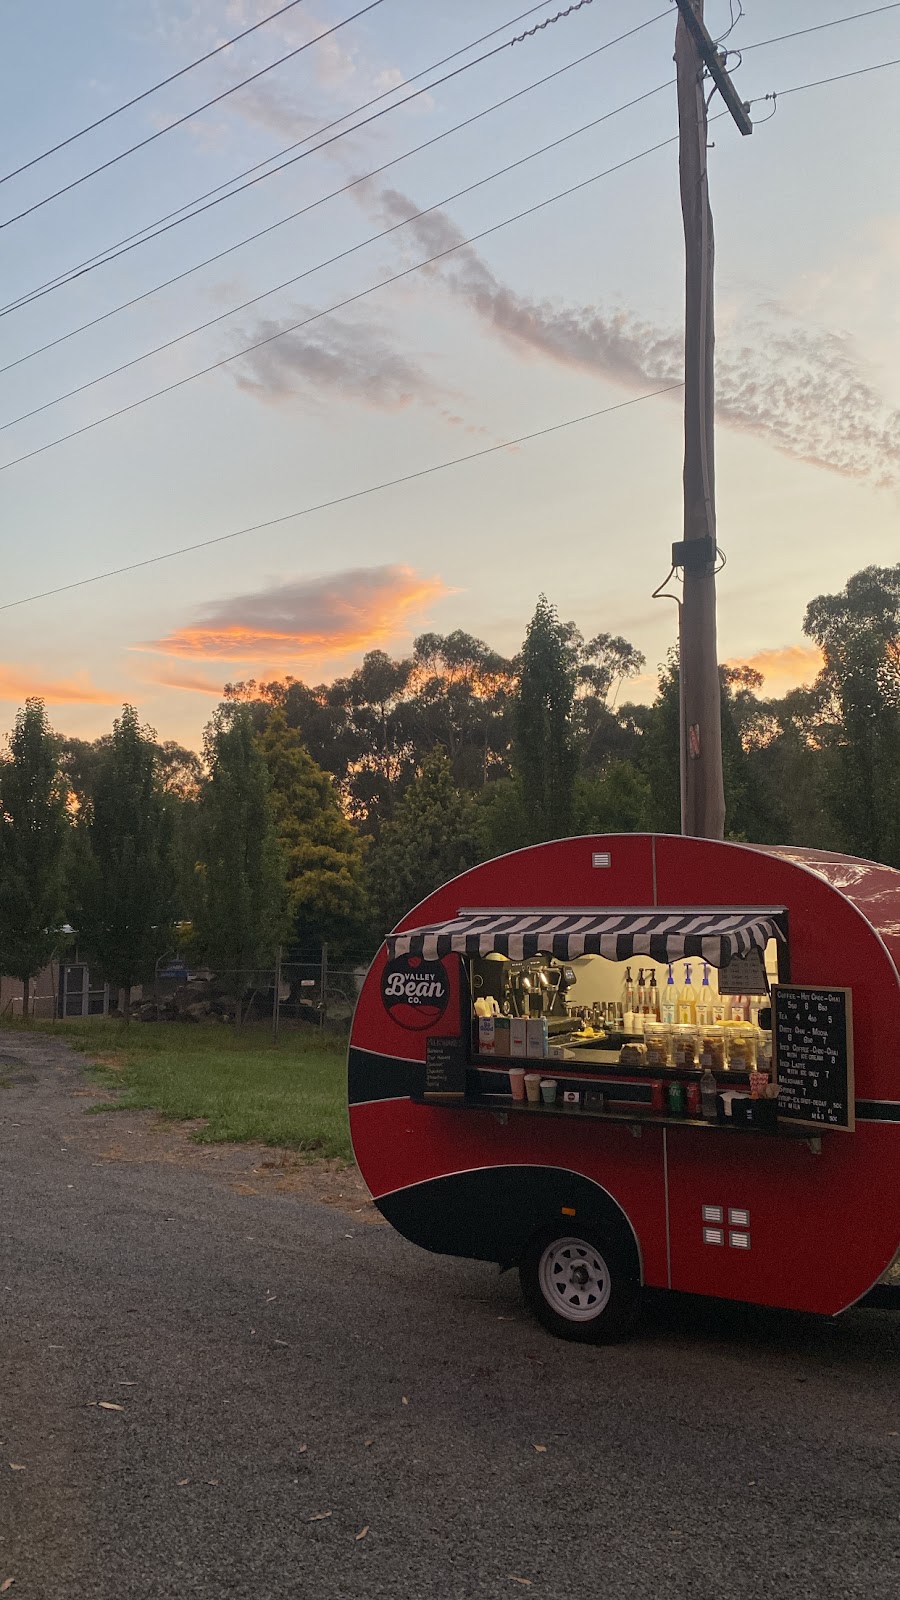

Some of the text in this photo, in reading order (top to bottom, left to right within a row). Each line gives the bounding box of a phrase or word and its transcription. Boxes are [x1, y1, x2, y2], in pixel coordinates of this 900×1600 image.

[405, 973, 435, 981] VALLEY
[384, 972, 445, 998] Bean
[777, 991, 796, 999] COFFEE
[407, 996, 422, 1004] CO.
[778, 1011, 788, 1020] TEA
[795, 1013, 800, 1021] 4
[827, 1015, 833, 1024] 5
[822, 1036, 827, 1045] 7
[791, 1060, 806, 1069] LATTE
[830, 1056, 836, 1064] 8
[825, 1070, 830, 1079] 7
[778, 1075, 818, 1087] MILKSHAKE 8
[801, 1087, 807, 1096] 7
